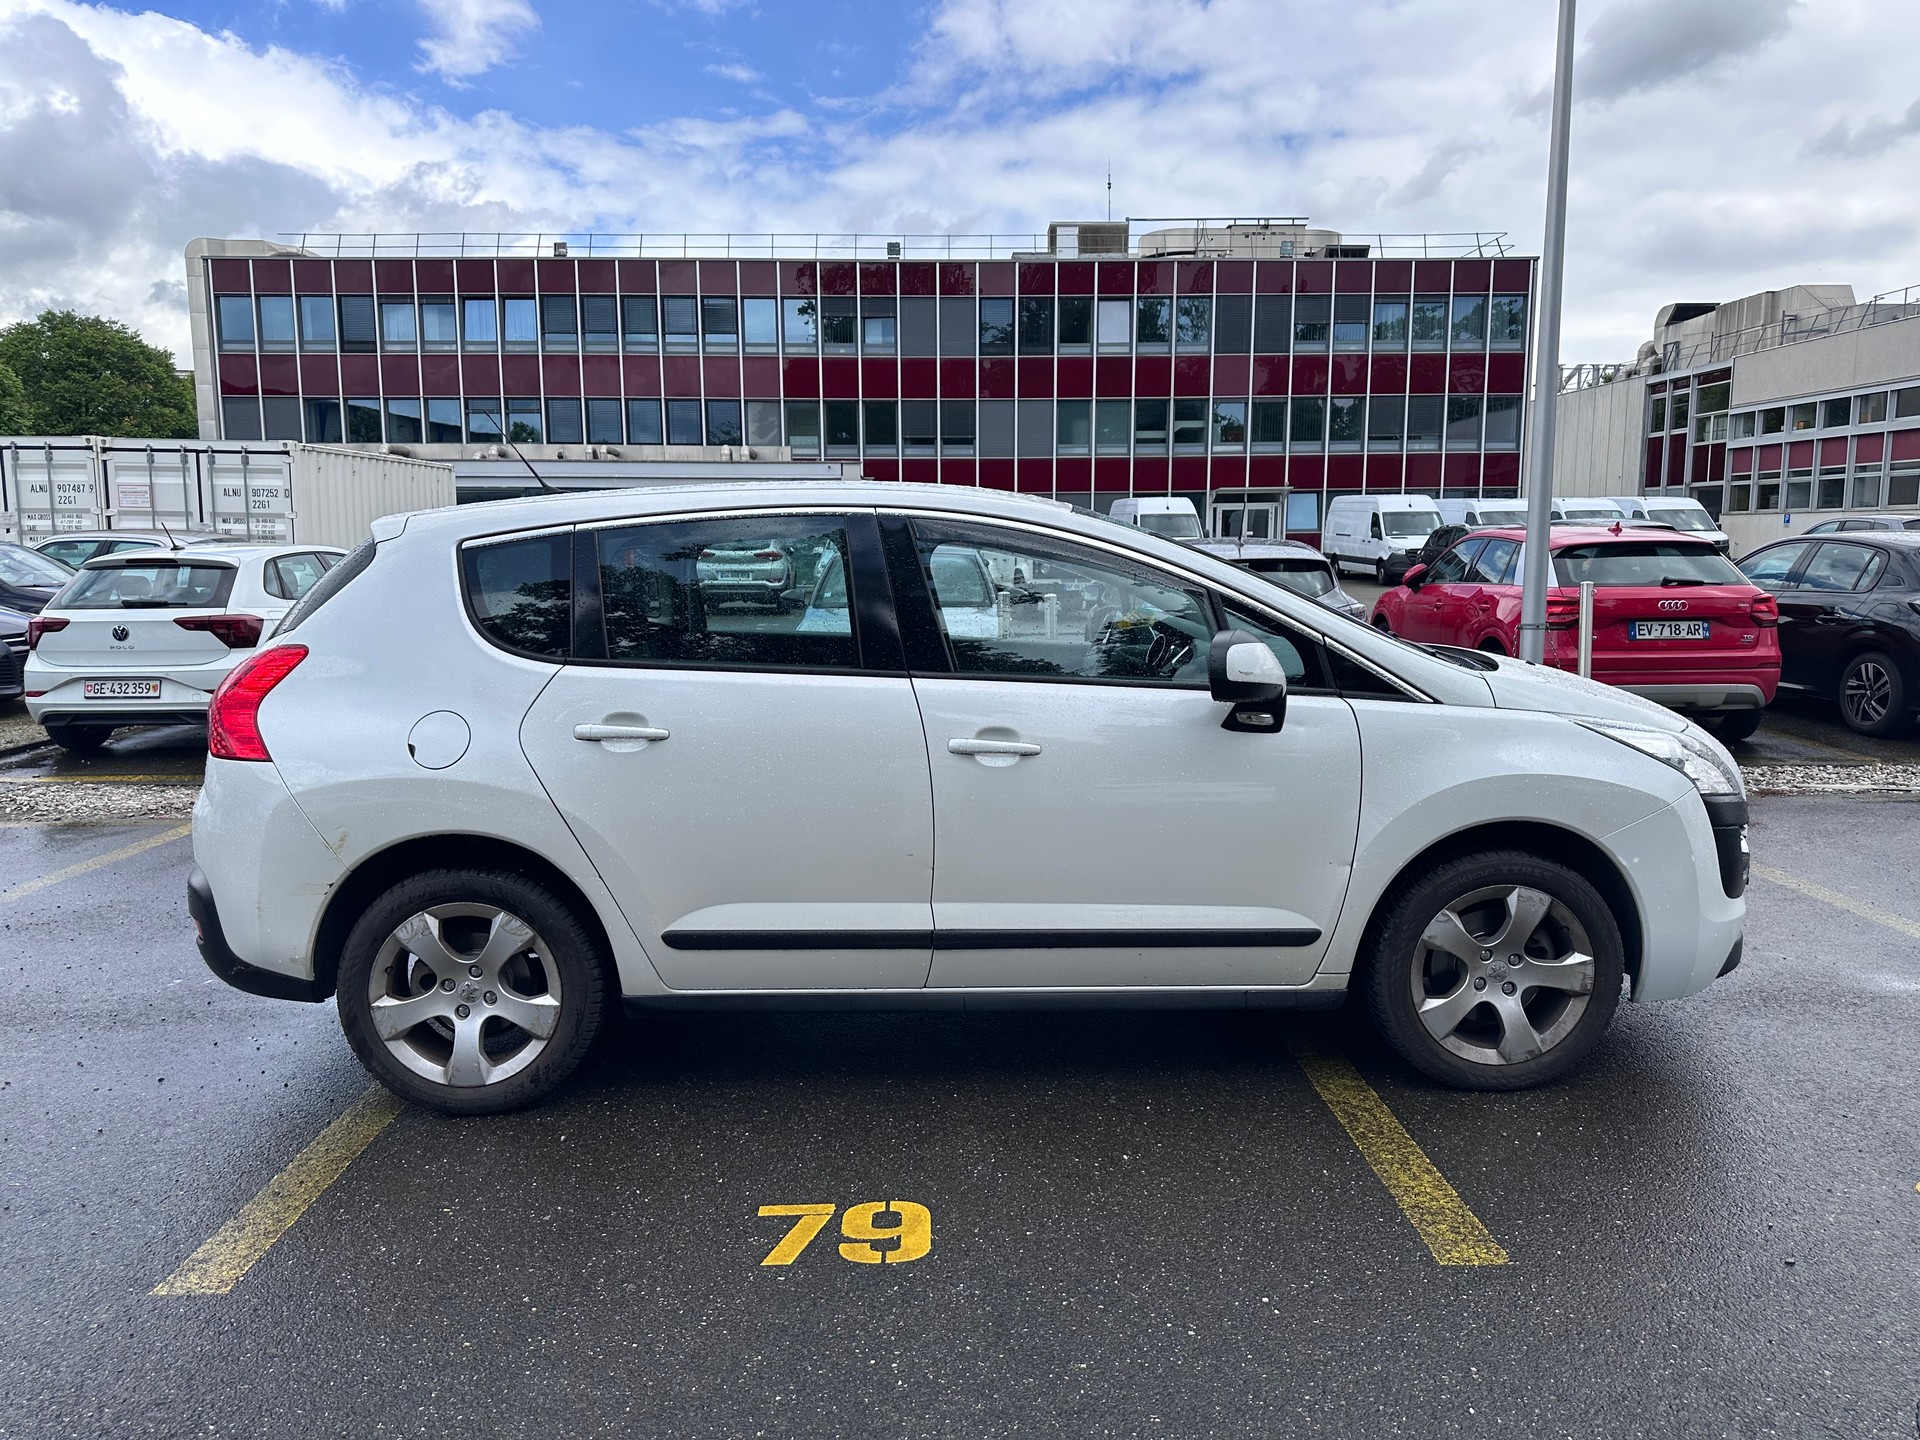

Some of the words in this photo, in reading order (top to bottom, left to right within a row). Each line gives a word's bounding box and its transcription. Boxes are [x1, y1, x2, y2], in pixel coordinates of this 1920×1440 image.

[30, 484, 48, 493] ALNU
[57, 484, 86, 493] 907487
[89, 484, 94, 494] 9
[223, 488, 241, 497] ALNU
[252, 488, 278, 497] 907252
[58, 495, 77, 504] 22G1
[253, 500, 270, 509] 22G1
[1637, 624, 1701, 636] EV-718-AR
[758, 1200, 932, 1266] 79
